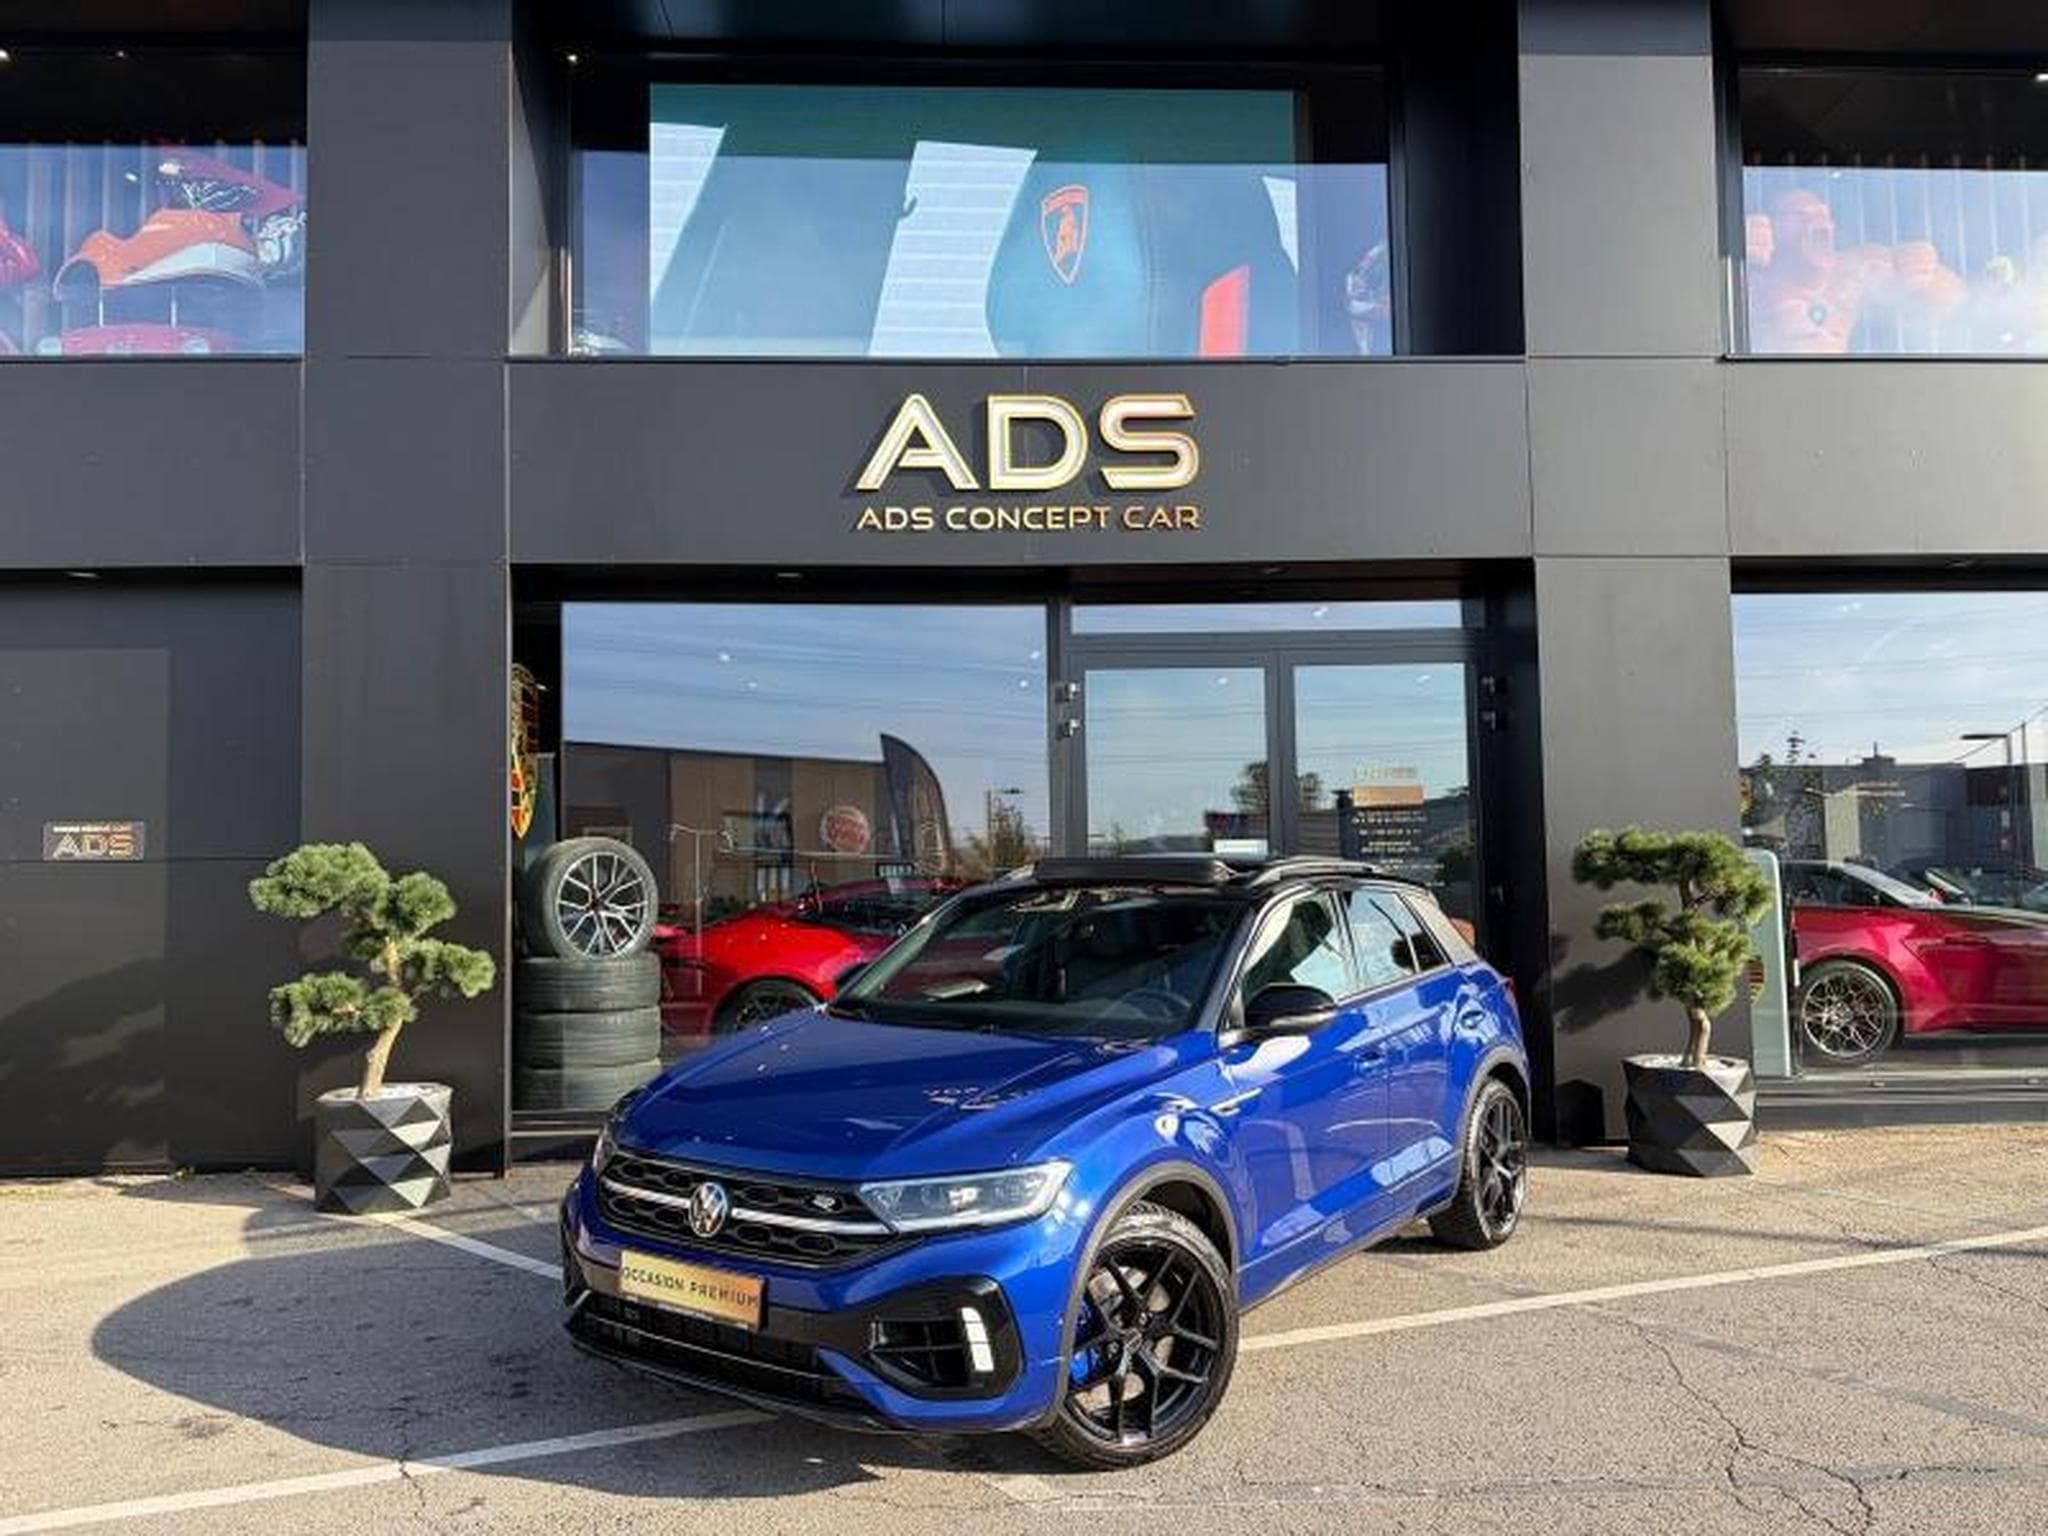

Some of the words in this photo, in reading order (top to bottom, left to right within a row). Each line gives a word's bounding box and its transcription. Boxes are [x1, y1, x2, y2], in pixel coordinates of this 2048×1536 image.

[855, 393, 1199, 490] ADS
[856, 507, 935, 530] ADS
[946, 506, 1110, 530] CONCEPT
[1123, 506, 1199, 530] CAR
[53, 833, 133, 858] ADS
[622, 1266, 684, 1290] OCCASION
[689, 1281, 758, 1306] PREMIUM
